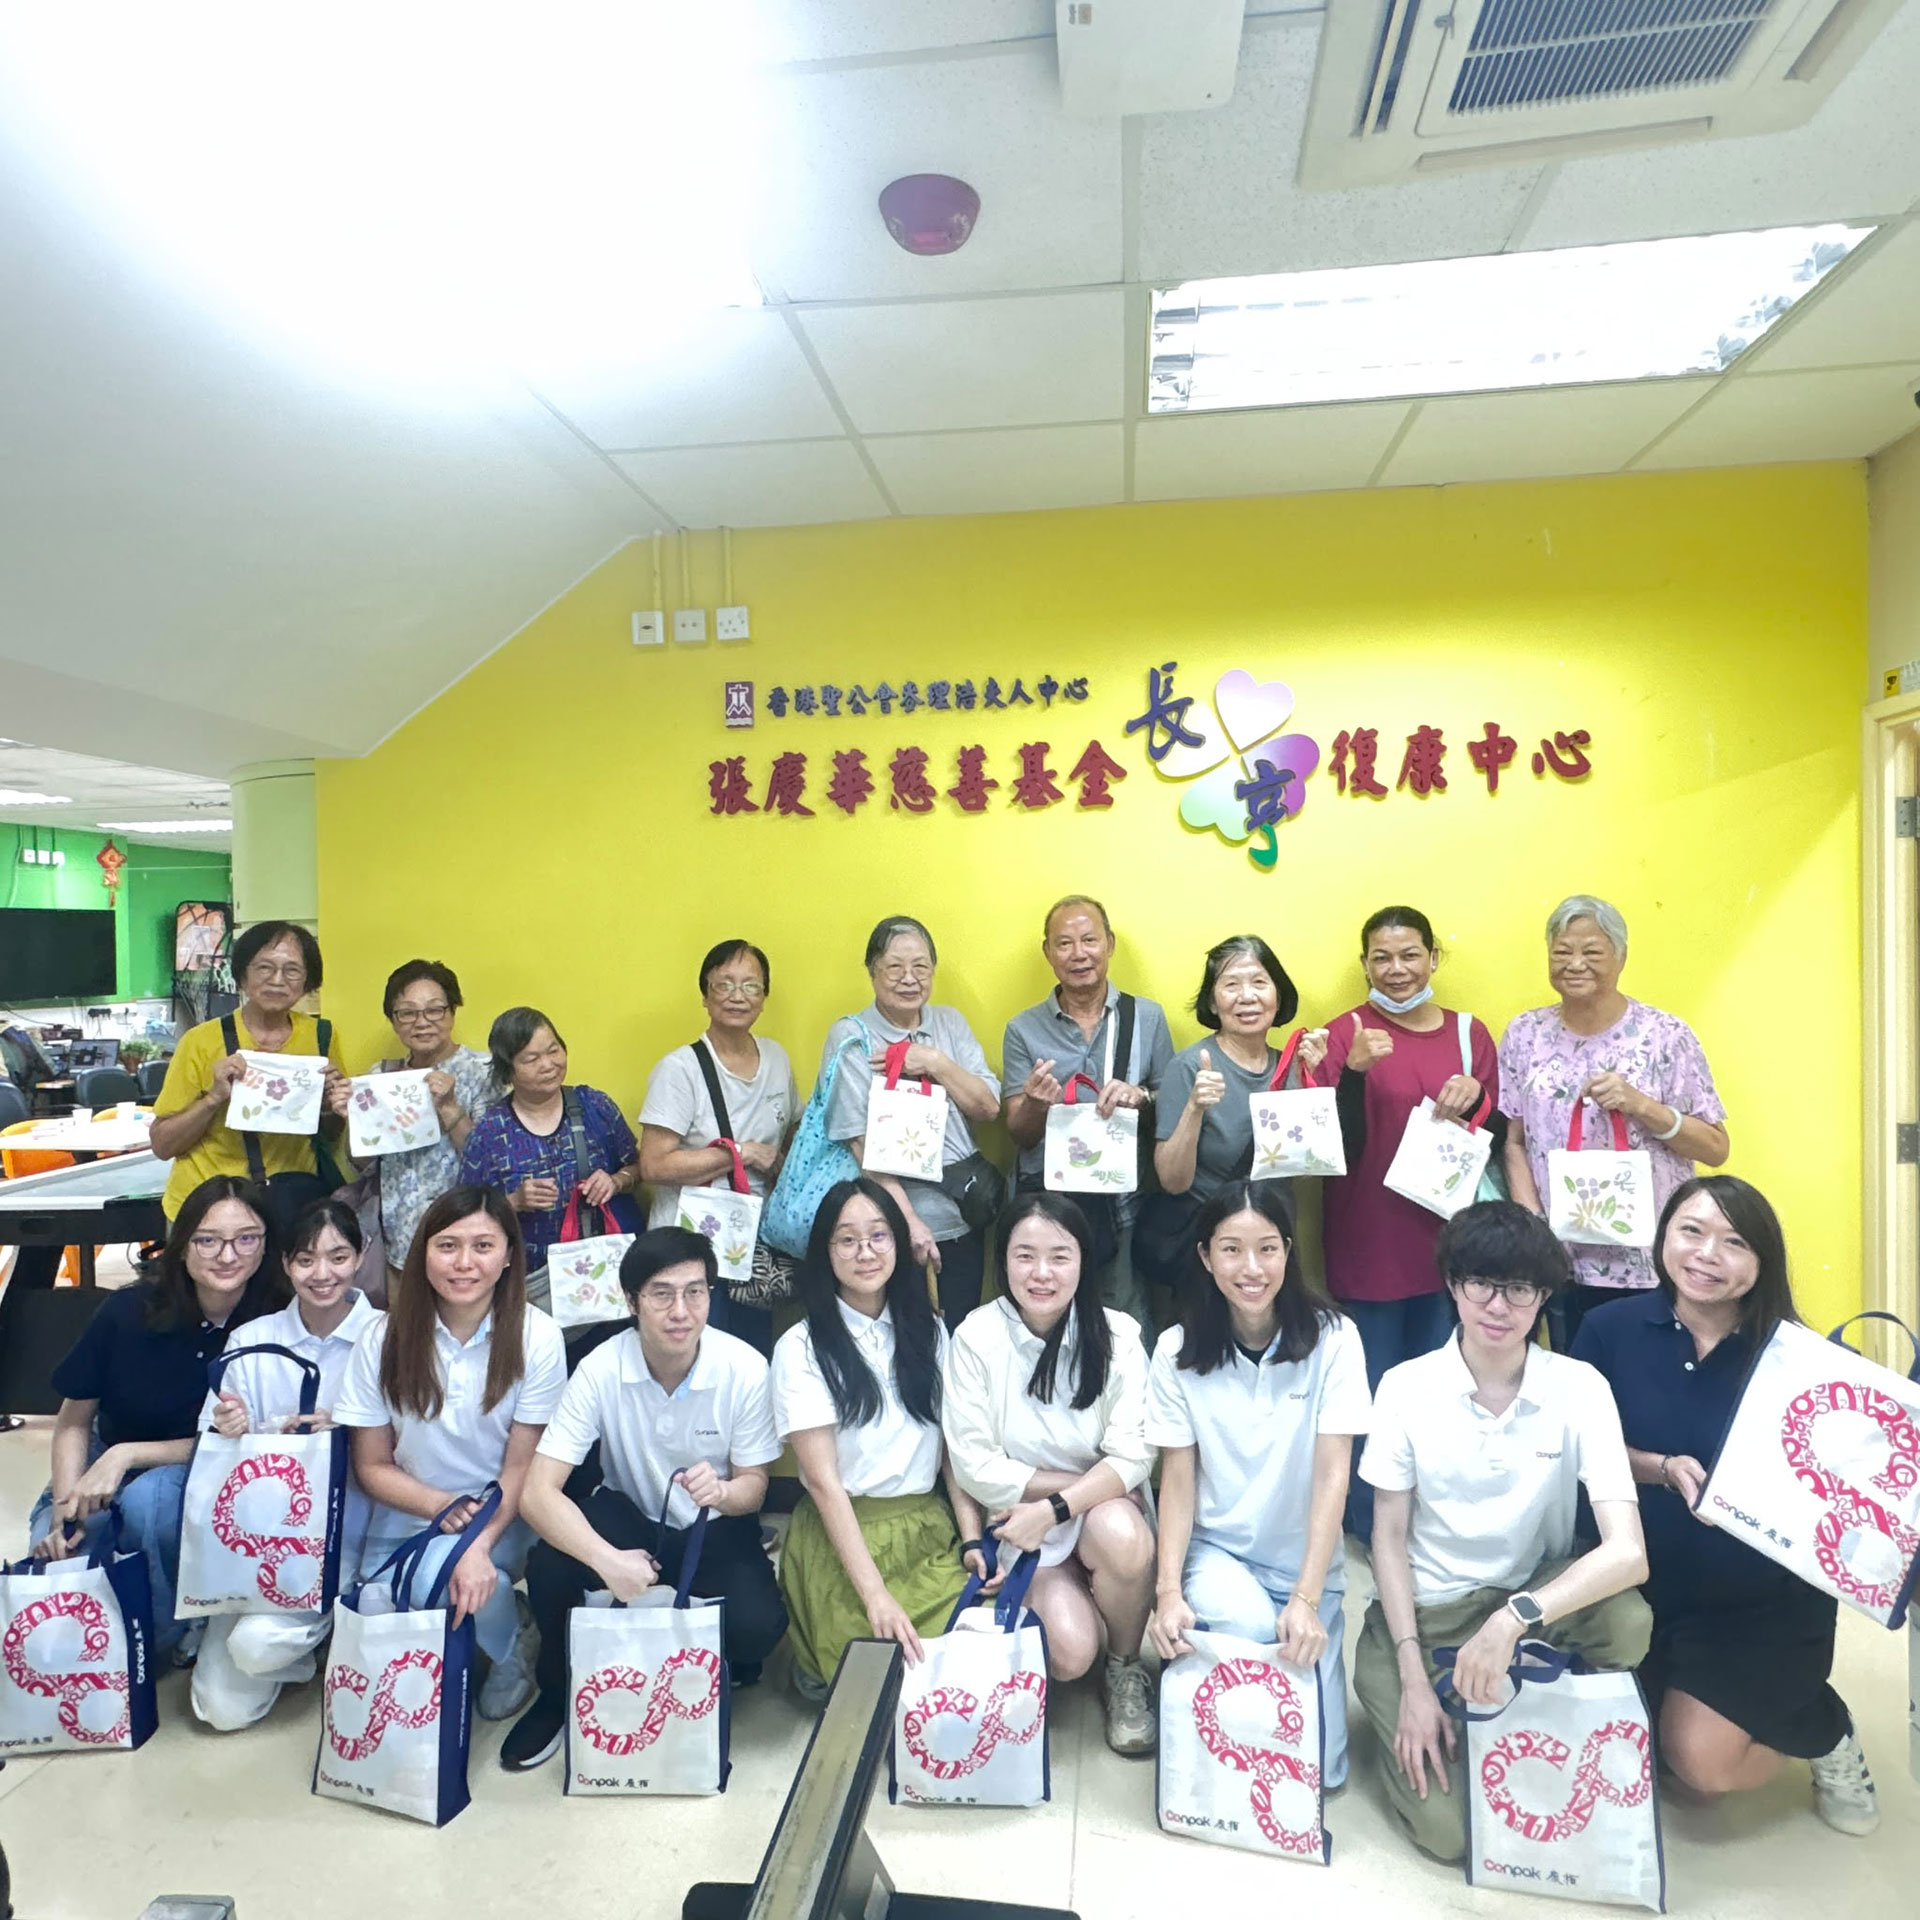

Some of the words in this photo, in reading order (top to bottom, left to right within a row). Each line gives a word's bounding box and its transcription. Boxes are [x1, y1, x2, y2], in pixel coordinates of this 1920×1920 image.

[708, 740, 1128, 816] 張慶華慈善基金
[1328, 721, 1592, 796] 復康中心
[1713, 1495, 1761, 1531] Conpak
[577, 1773, 620, 1787] Conpak
[1166, 1809, 1211, 1827] Conpak
[1483, 1858, 1541, 1879] Conpak
